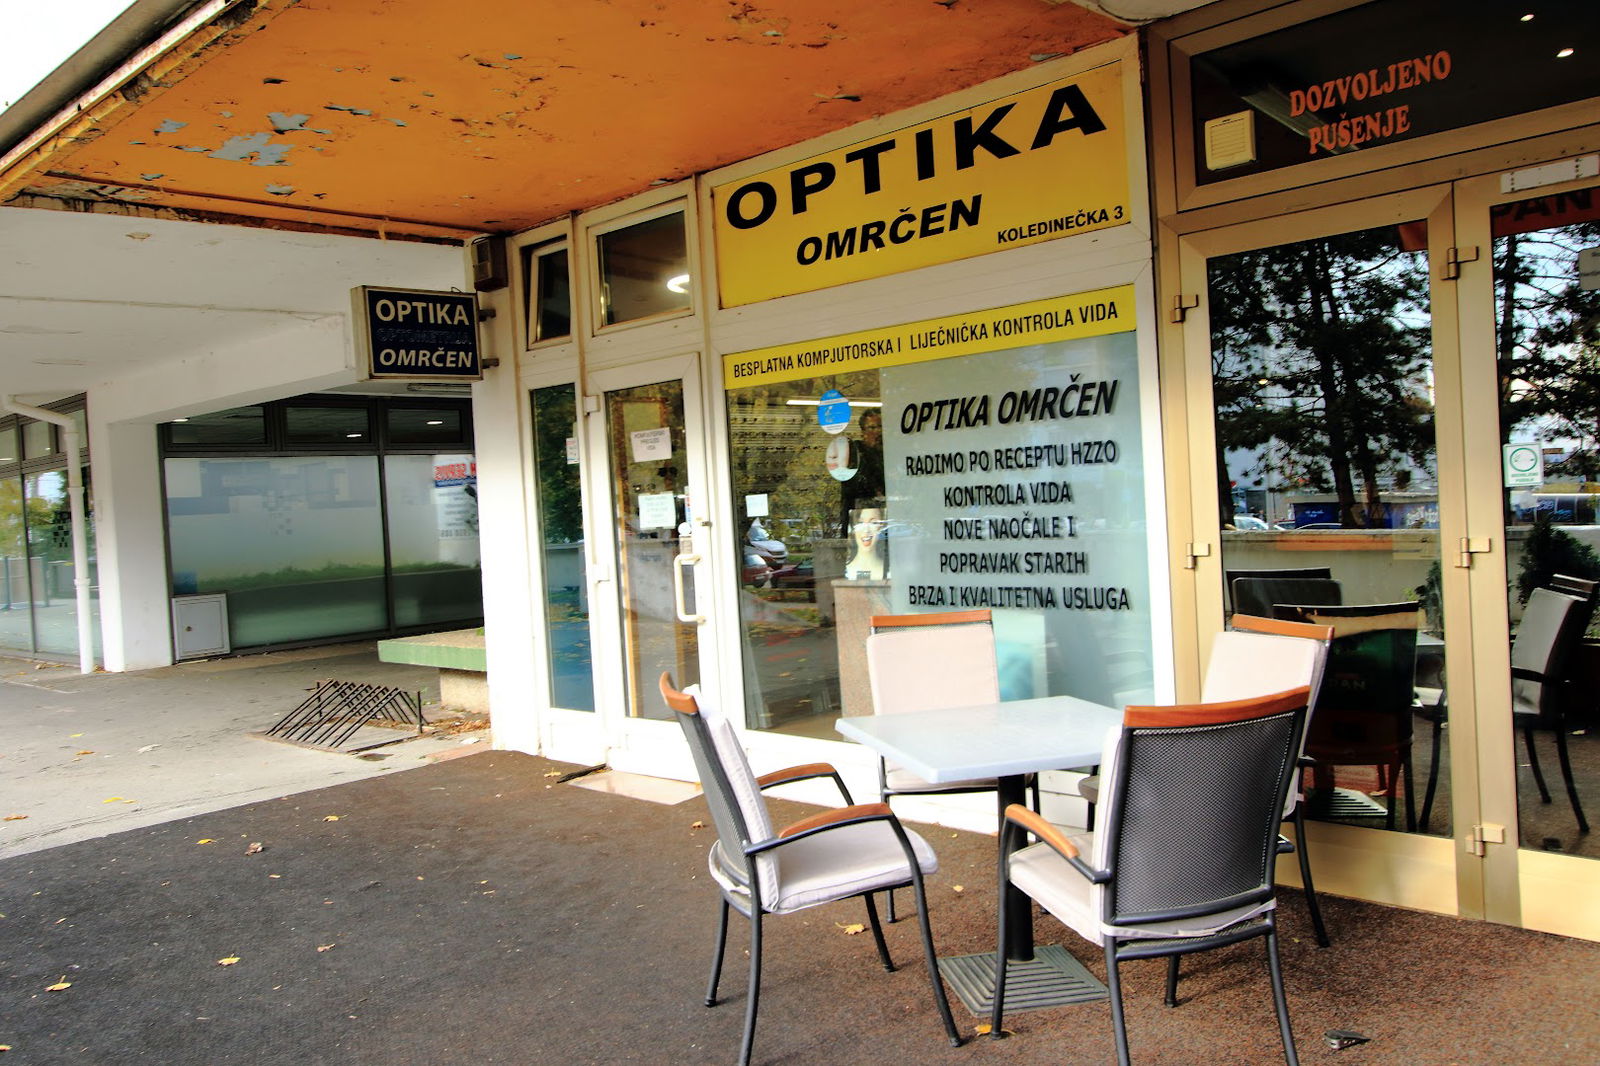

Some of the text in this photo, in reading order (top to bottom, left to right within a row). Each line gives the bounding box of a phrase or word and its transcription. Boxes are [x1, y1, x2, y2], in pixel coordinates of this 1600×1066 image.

[1289, 50, 1452, 118] DOZVOLJENO
[1308, 104, 1411, 155] PUŠENJE
[726, 83, 1107, 231] OPTIKA
[796, 194, 983, 266] OMRČEN
[997, 205, 1124, 244] KOLEDINEČKA 3
[375, 299, 470, 326] OPTIKA
[380, 347, 473, 368] OMRČEN
[734, 355, 794, 378] BESPLATNA
[797, 338, 893, 369] KOMPJUTORSKA
[993, 309, 1074, 337] KONTROLA
[1079, 301, 1119, 324] VIDA
[901, 374, 1118, 434] OPTIKA OMRČEN
[906, 440, 1117, 476] RADIMO PO RECEPTU HZZO
[944, 481, 1071, 507] KONTROLA VIDA
[944, 511, 1075, 540] NOVE NAOČALE I
[940, 552, 1085, 573] POPRAVAK STARIH
[909, 586, 944, 605] BRZA
[960, 587, 1055, 608] KVALITETNA
[1063, 587, 1130, 610] USLUGA
